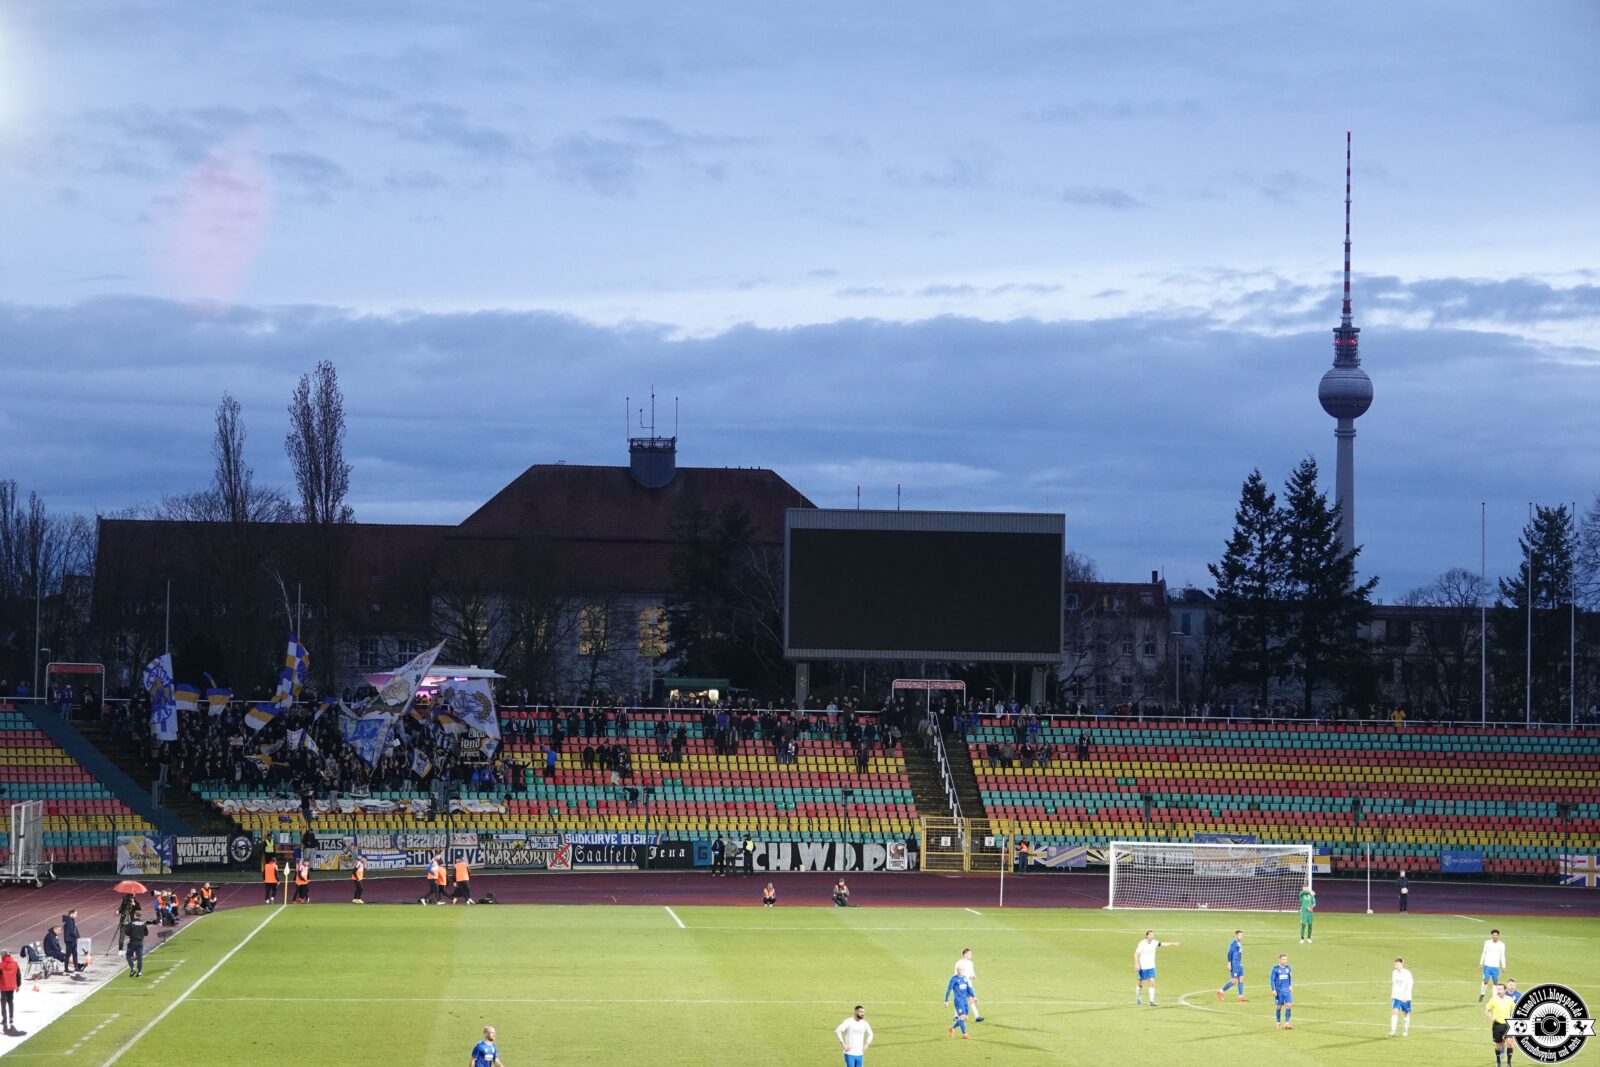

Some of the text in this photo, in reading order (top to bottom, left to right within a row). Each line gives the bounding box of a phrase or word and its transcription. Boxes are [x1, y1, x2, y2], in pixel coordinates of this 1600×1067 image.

[565, 834, 657, 844] SÜDKURVE BLEIBT
[176, 843, 228, 856] WOLFPACK
[485, 849, 546, 864] HARAKIRI
[575, 845, 637, 864] Saalfeld
[648, 846, 685, 860] Jena
